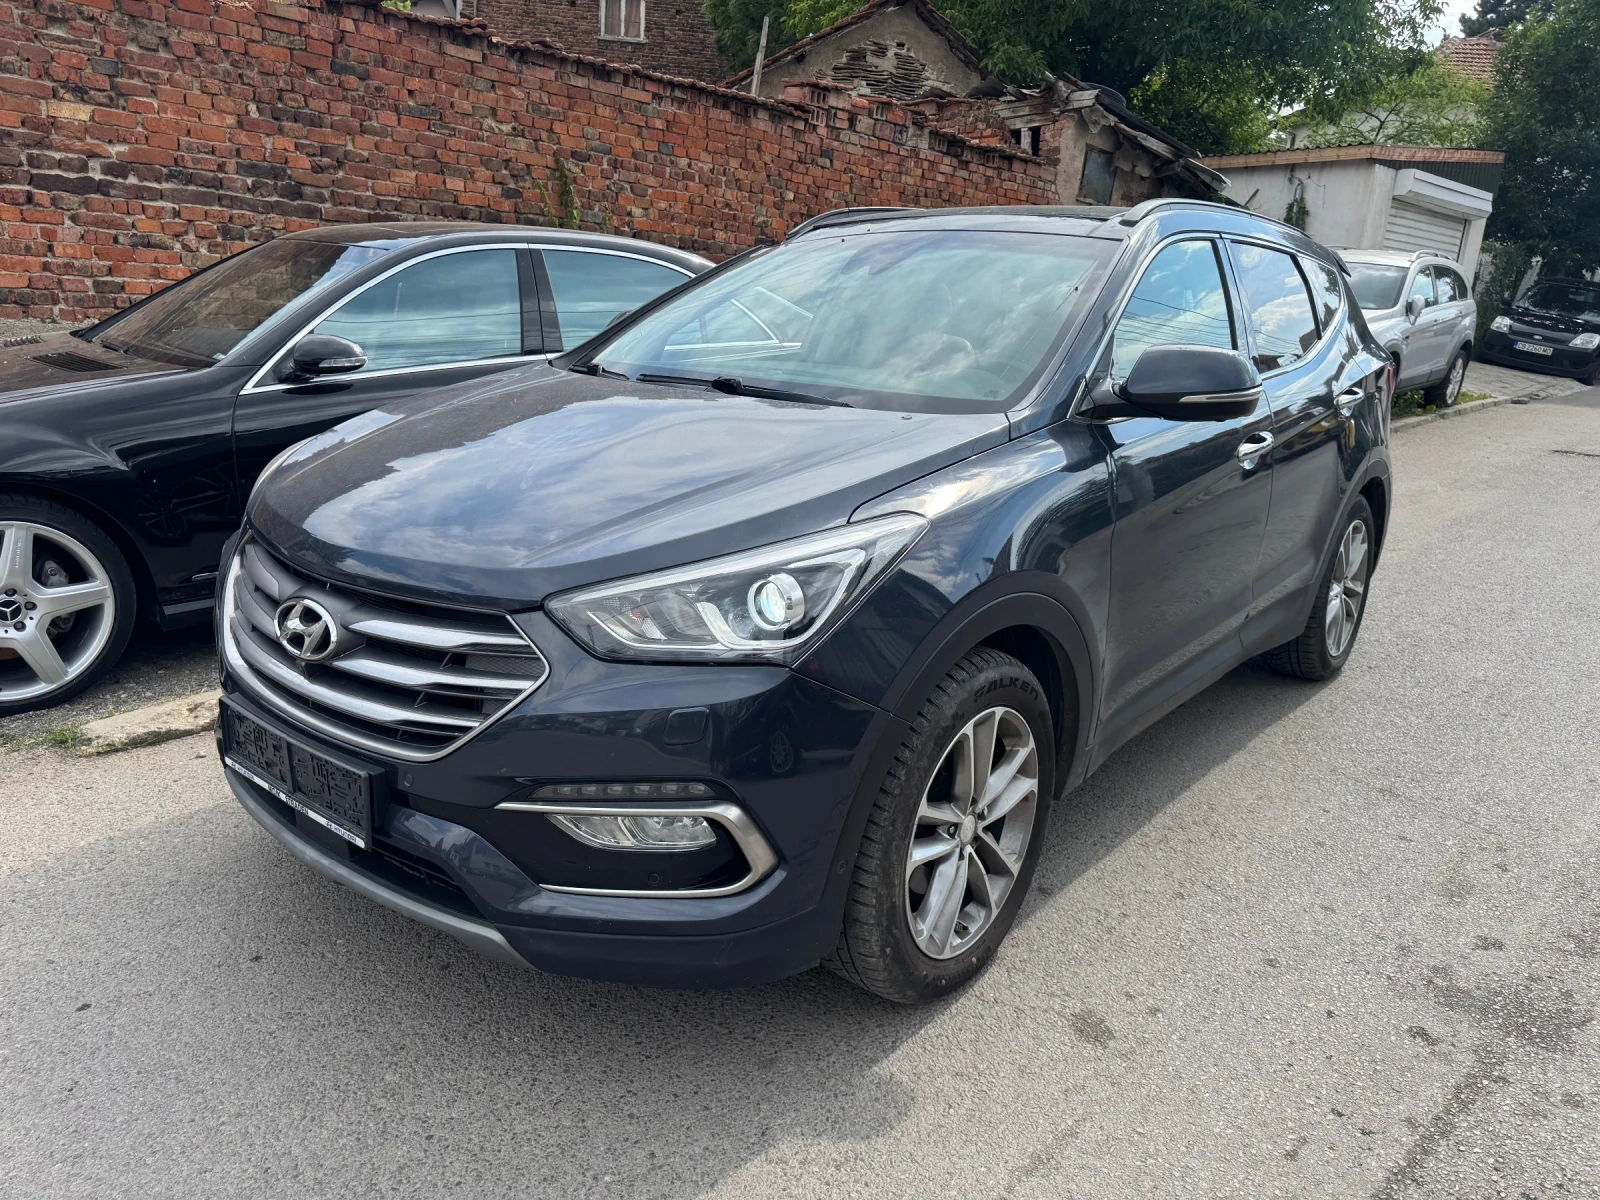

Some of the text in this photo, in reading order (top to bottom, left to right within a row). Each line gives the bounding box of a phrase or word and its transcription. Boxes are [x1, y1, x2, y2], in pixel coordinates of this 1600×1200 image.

[1527, 343, 1542, 353] 2260
[973, 677, 1039, 702] FALKEN
[333, 824, 357, 843] HYUNDAI
